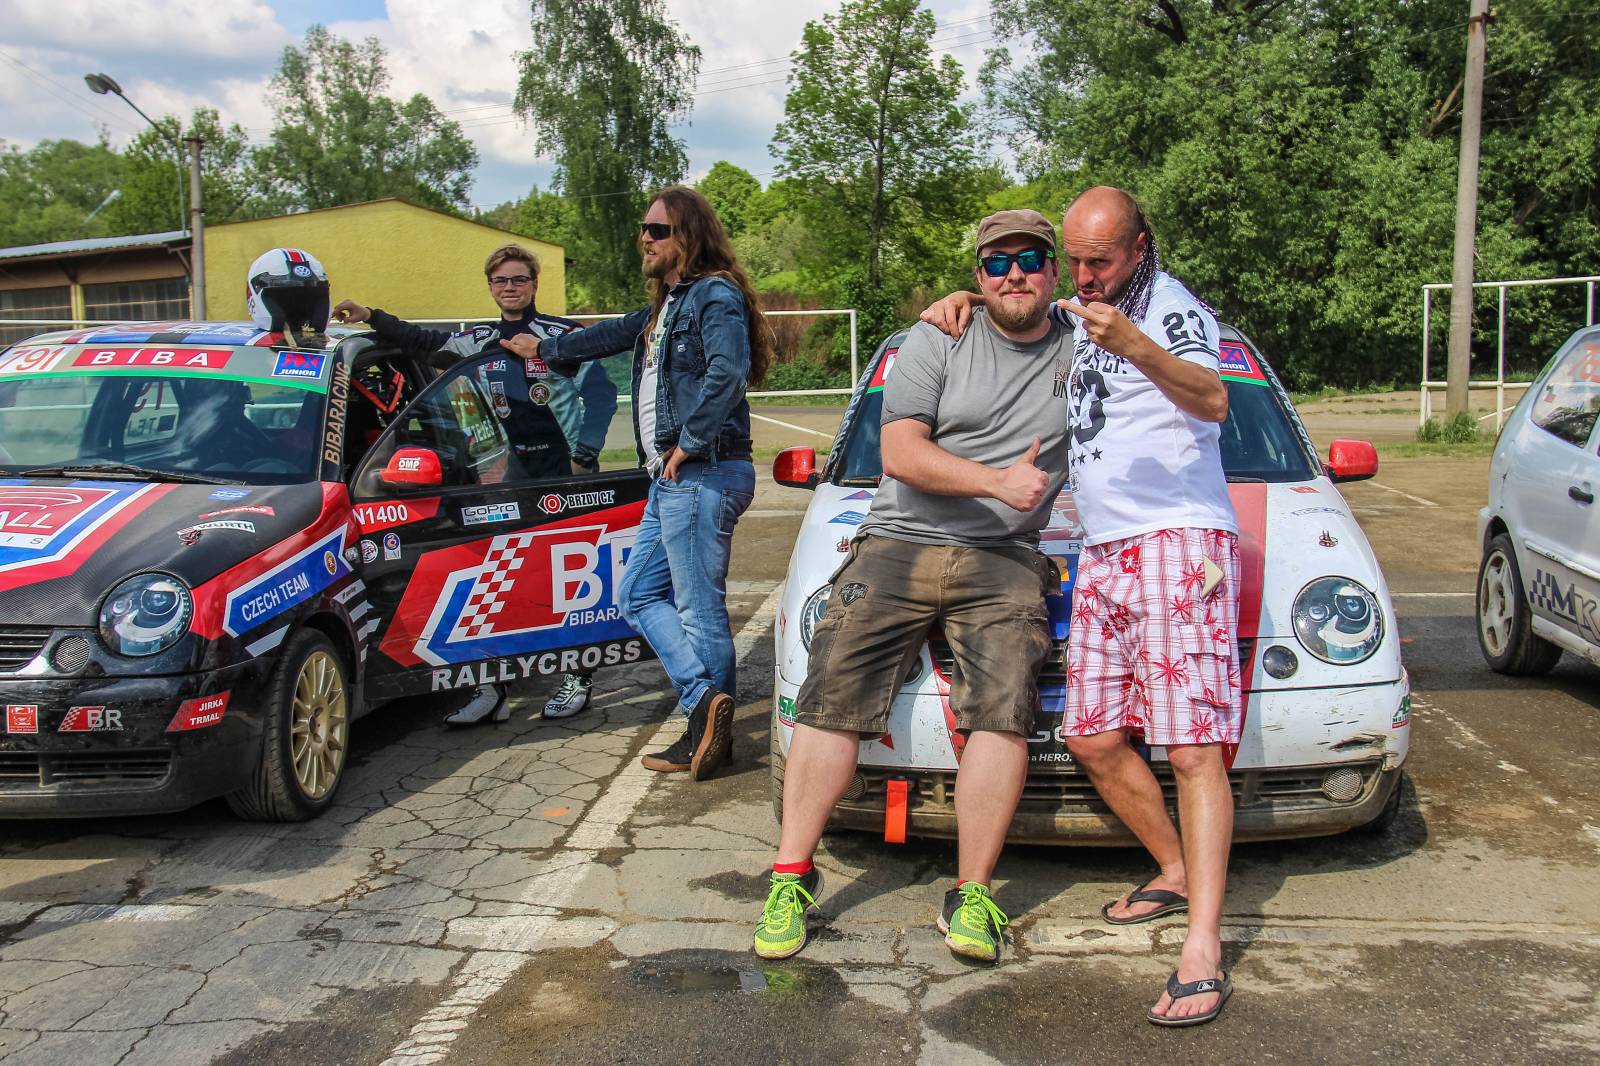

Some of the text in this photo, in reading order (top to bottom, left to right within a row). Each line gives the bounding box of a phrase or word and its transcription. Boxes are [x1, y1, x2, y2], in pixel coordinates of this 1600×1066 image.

[1162, 310, 1208, 344] 23
[279, 368, 317, 377] JUNIOR
[325, 362, 351, 465] BIBARACING
[398, 457, 420, 471] OMP
[567, 494, 599, 508] BRZDY
[352, 504, 408, 525] N1400
[465, 504, 515, 516] GoPro
[241, 591, 281, 622] CZECH
[279, 572, 310, 602] TEAM
[431, 640, 642, 692] RALLYCROSS
[199, 698, 224, 712] JIRKA
[87, 709, 123, 728] BR
[190, 713, 220, 726] TRMAL
[1039, 753, 1072, 762] HERO.
